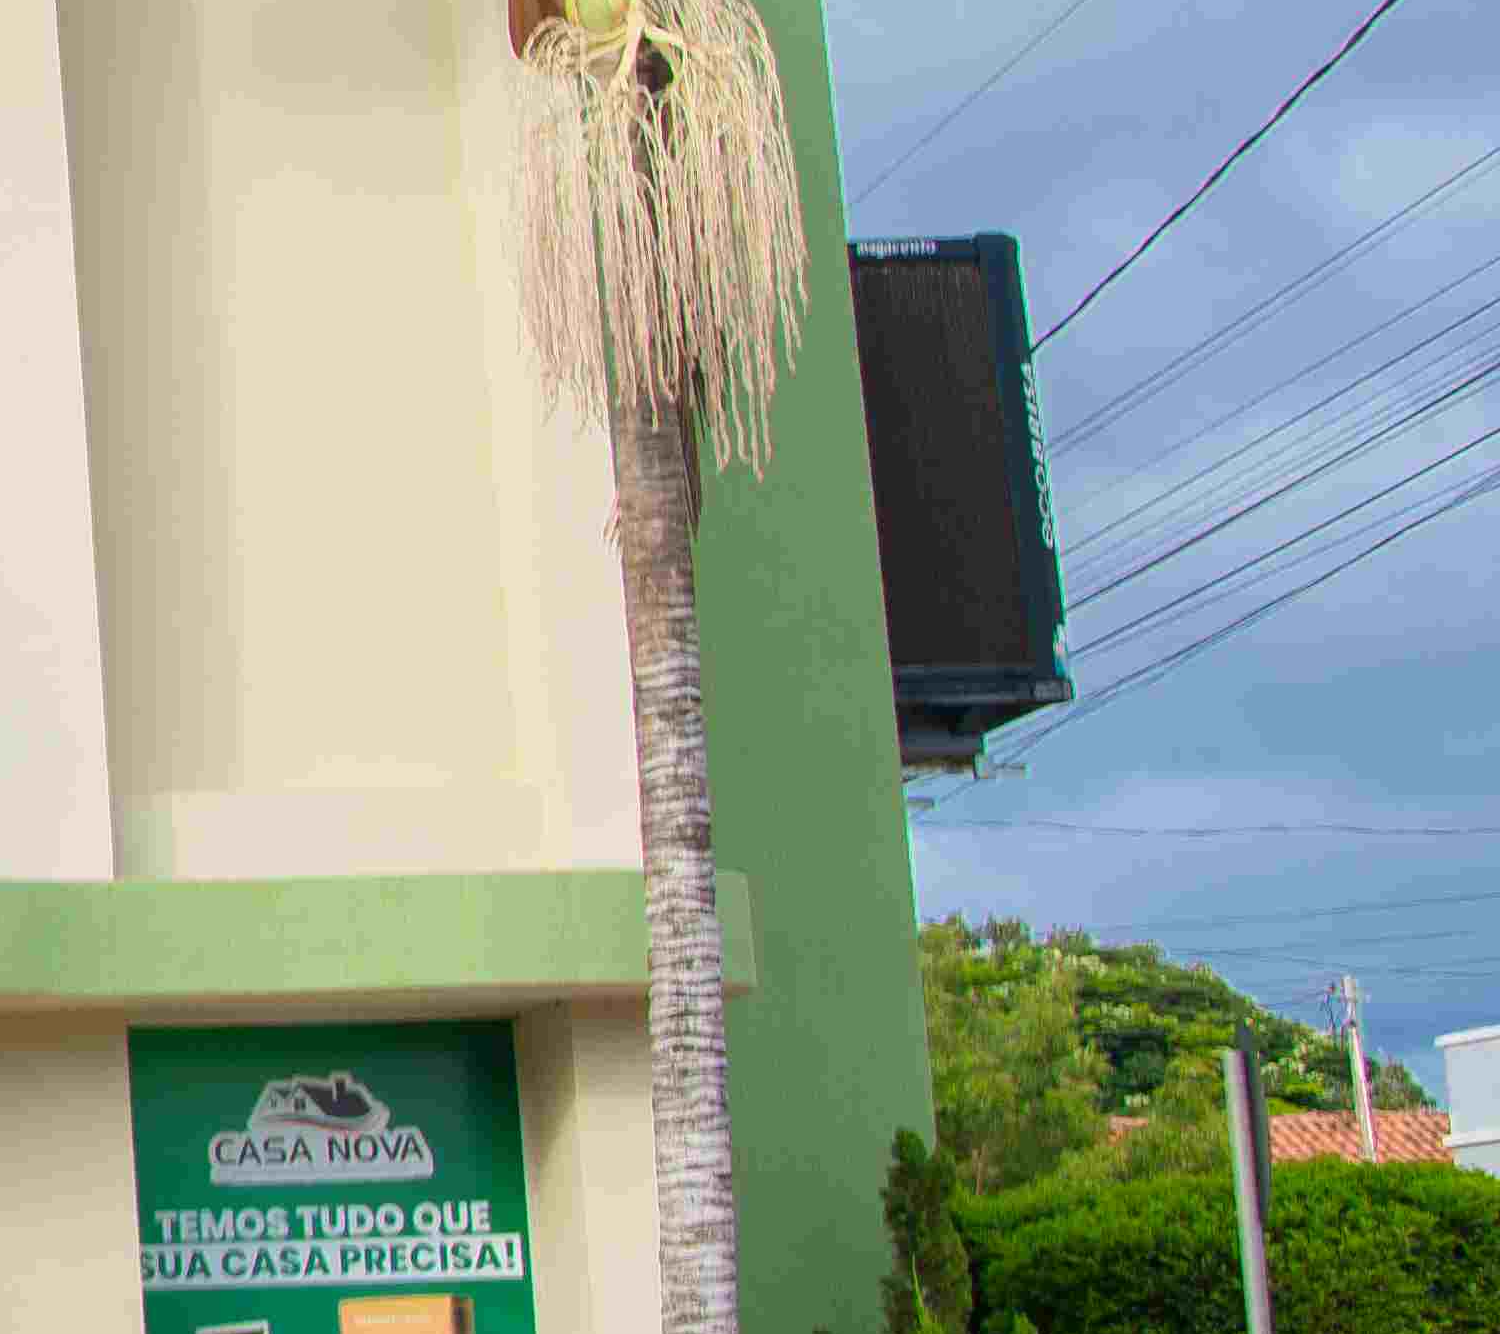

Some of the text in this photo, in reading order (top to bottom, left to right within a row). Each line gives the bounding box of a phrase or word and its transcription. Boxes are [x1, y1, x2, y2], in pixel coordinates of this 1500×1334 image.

[214, 1131, 426, 1166] CASA NOVA
[155, 1199, 491, 1244] TEMOS TUDO QUE
[141, 1240, 515, 1281] SUA CASA PRECISA!
